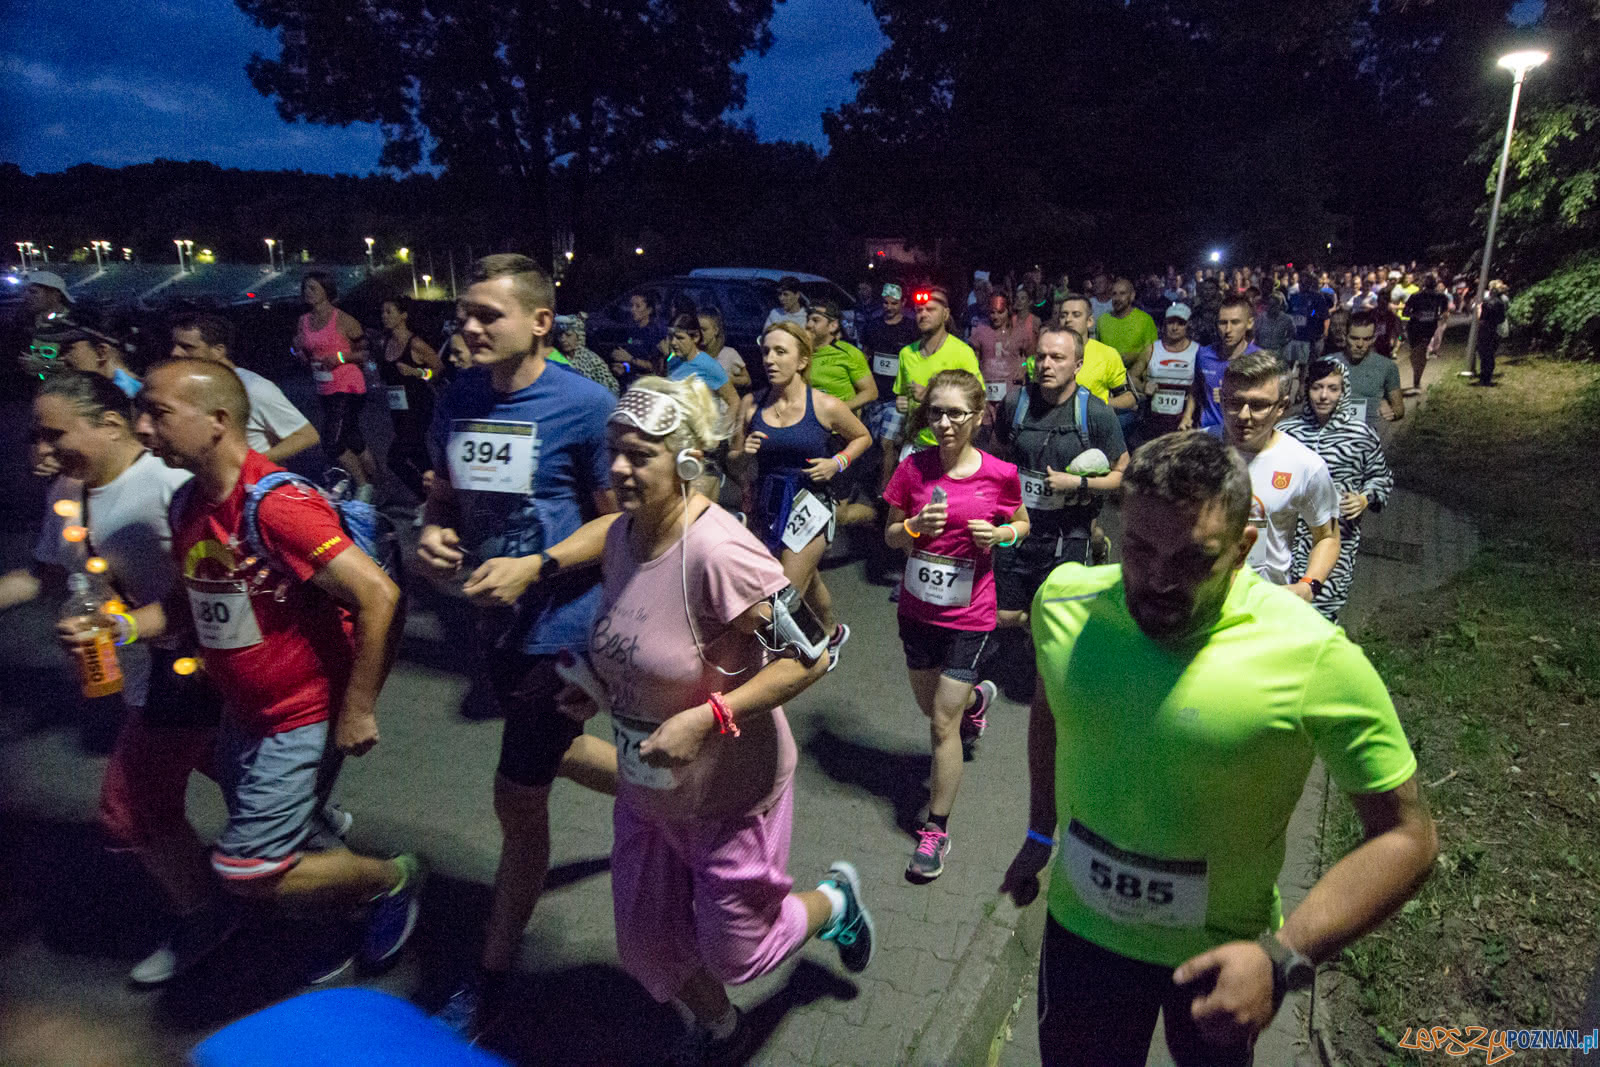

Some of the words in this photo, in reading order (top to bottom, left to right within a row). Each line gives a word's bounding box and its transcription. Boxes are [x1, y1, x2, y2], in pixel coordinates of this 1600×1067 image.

[880, 359, 891, 368] 62
[1157, 396, 1178, 406] 310
[461, 440, 513, 465] 394
[787, 505, 812, 535] 237
[918, 567, 959, 588] 637
[1089, 857, 1174, 905] 585
